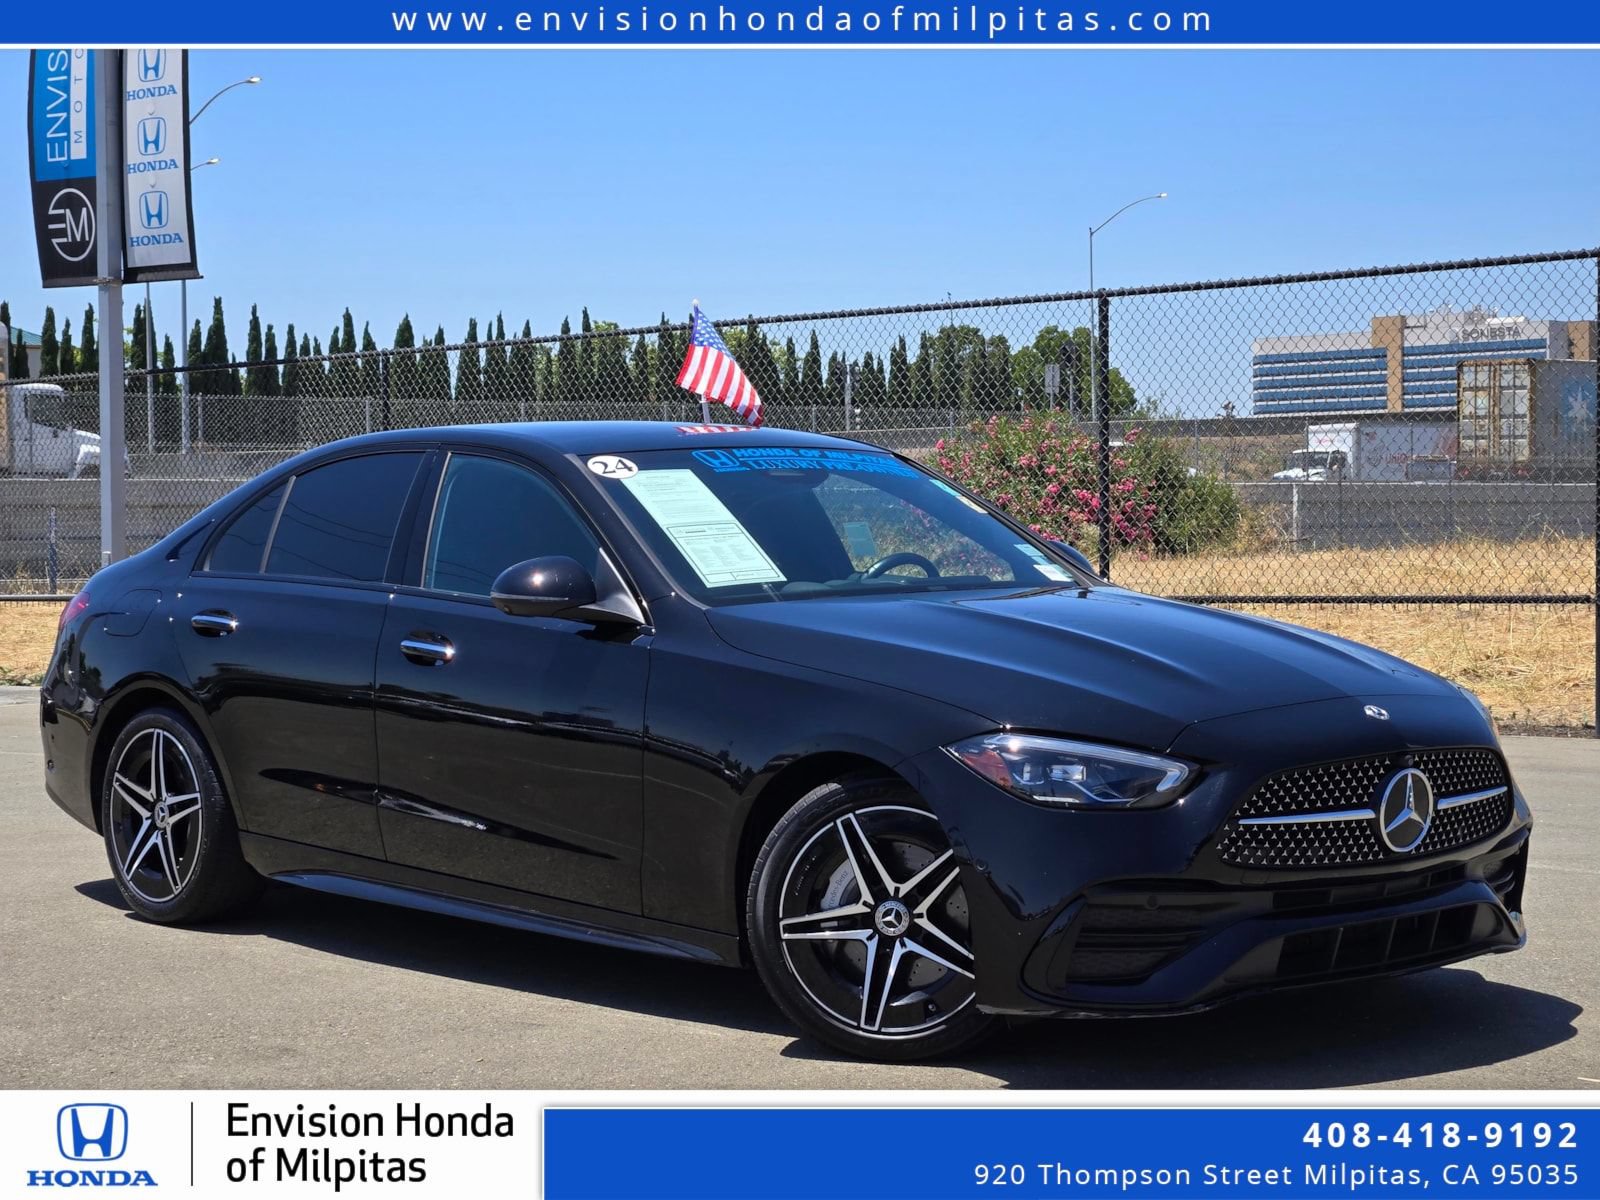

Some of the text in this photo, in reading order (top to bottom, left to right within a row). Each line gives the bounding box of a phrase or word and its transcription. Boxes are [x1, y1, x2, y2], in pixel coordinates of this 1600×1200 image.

[127, 84, 178, 101] HONDA
[128, 158, 179, 174] HONDA
[130, 232, 184, 248] HONDA
[1461, 326, 1520, 342] SONESTA
[731, 447, 800, 458] HONDA
[798, 448, 822, 458] OF
[592, 459, 634, 474] 24
[746, 459, 822, 470] LUXURY
